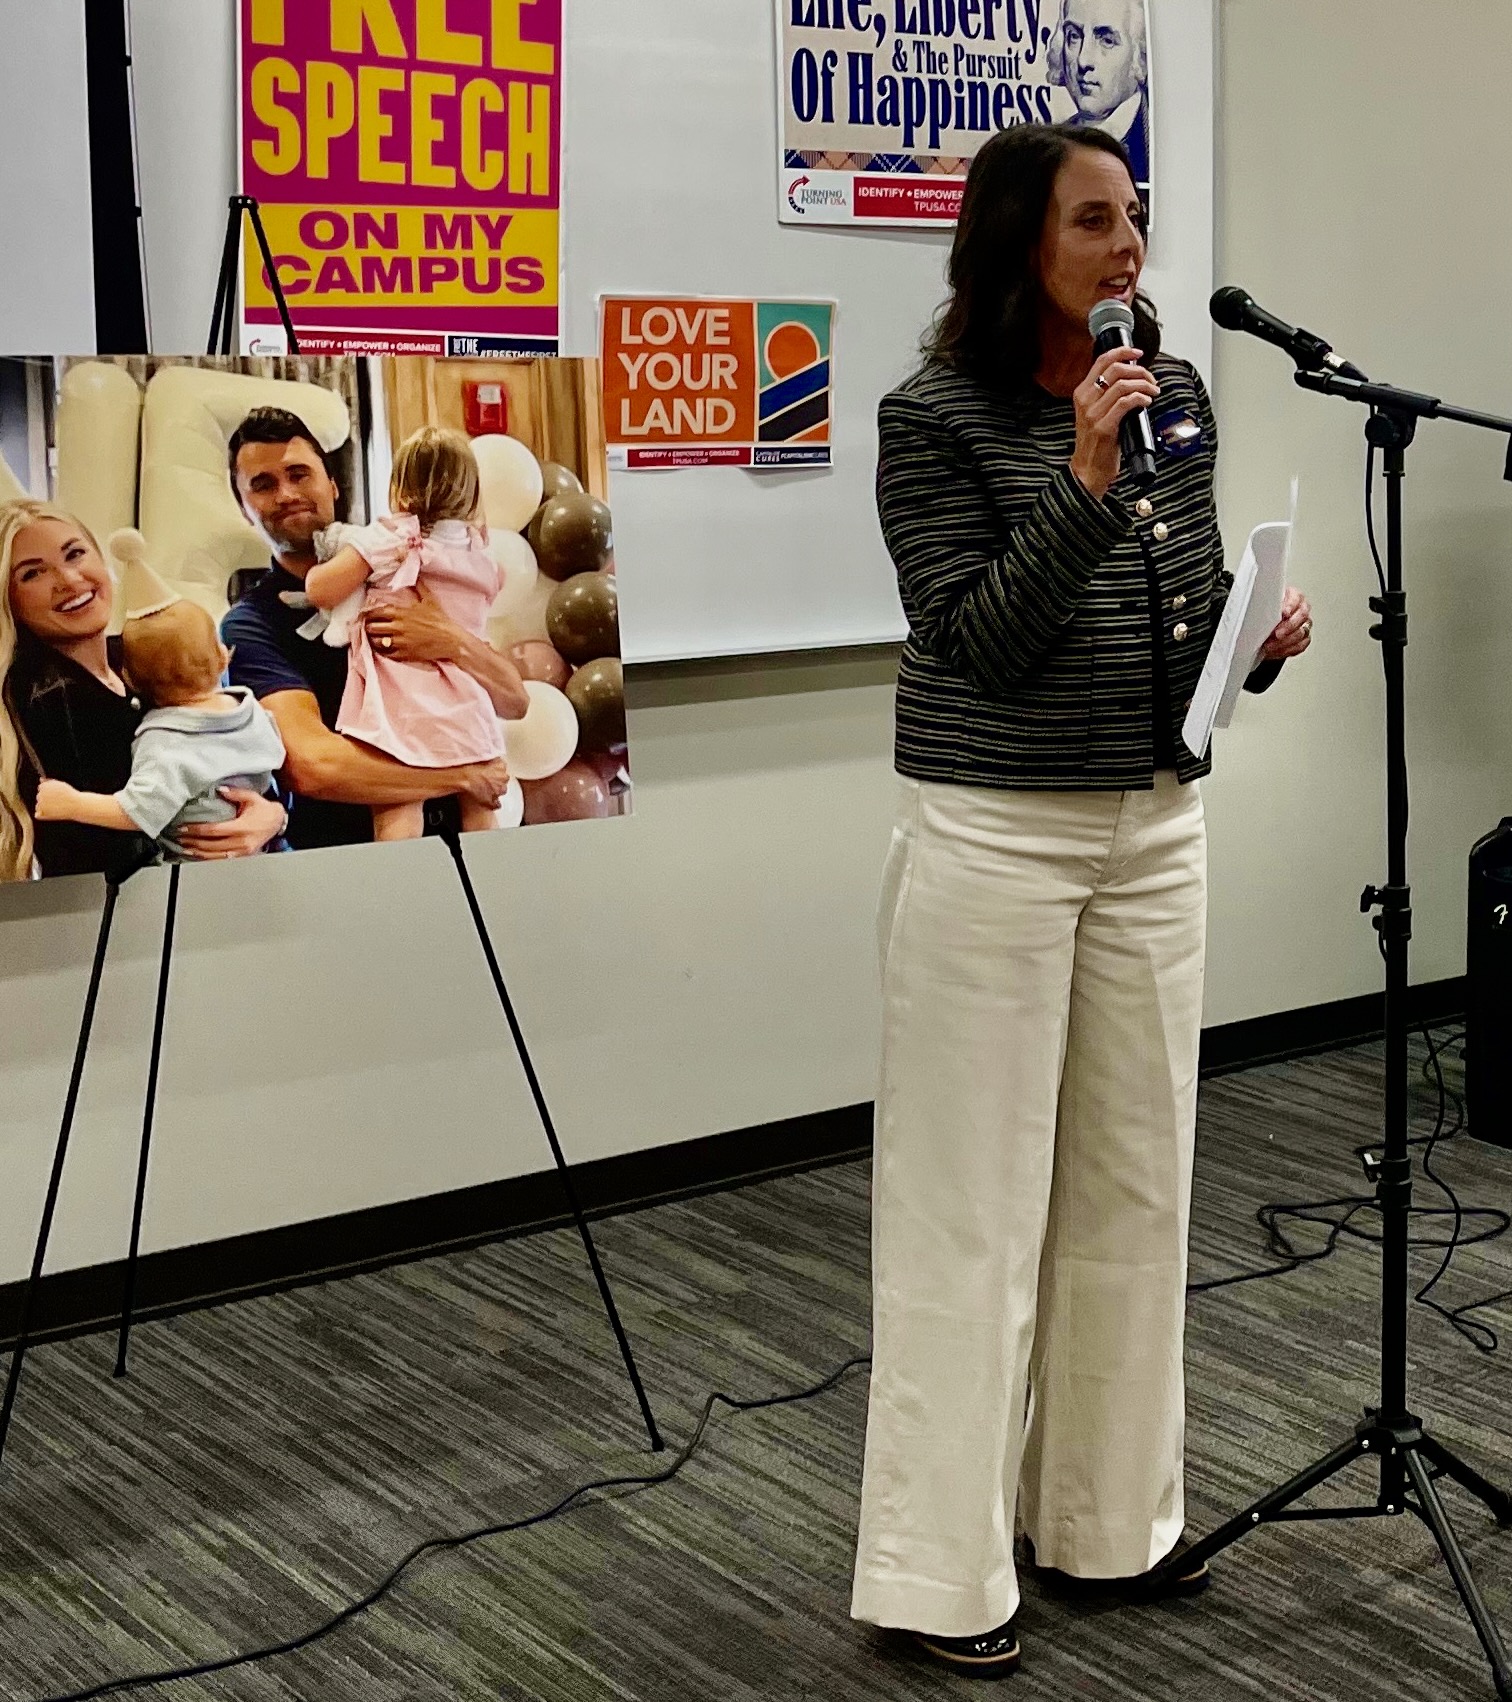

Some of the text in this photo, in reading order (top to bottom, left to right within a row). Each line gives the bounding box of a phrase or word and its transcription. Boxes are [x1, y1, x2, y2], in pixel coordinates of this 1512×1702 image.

[892, 39, 1022, 81] & The Pursuit
[791, 48, 1052, 149] Of Happiness
[251, 57, 550, 196] SPEECH
[800, 188, 843, 199] TURNING
[801, 197, 847, 206] POINT USA
[858, 187, 963, 200] IDENTIFY EMPOWER
[914, 201, 962, 213] TPUSA.CO
[299, 210, 513, 251] ON MY
[262, 255, 545, 295] CAMPUS
[297, 338, 335, 349] DENTIFY
[343, 338, 389, 350] EMPOWER
[396, 342, 441, 353] ORGANIZE
[621, 306, 731, 346] LOVE
[461, 338, 479, 354] THE
[617, 352, 738, 391] YOUR
[621, 397, 736, 436] LAND
